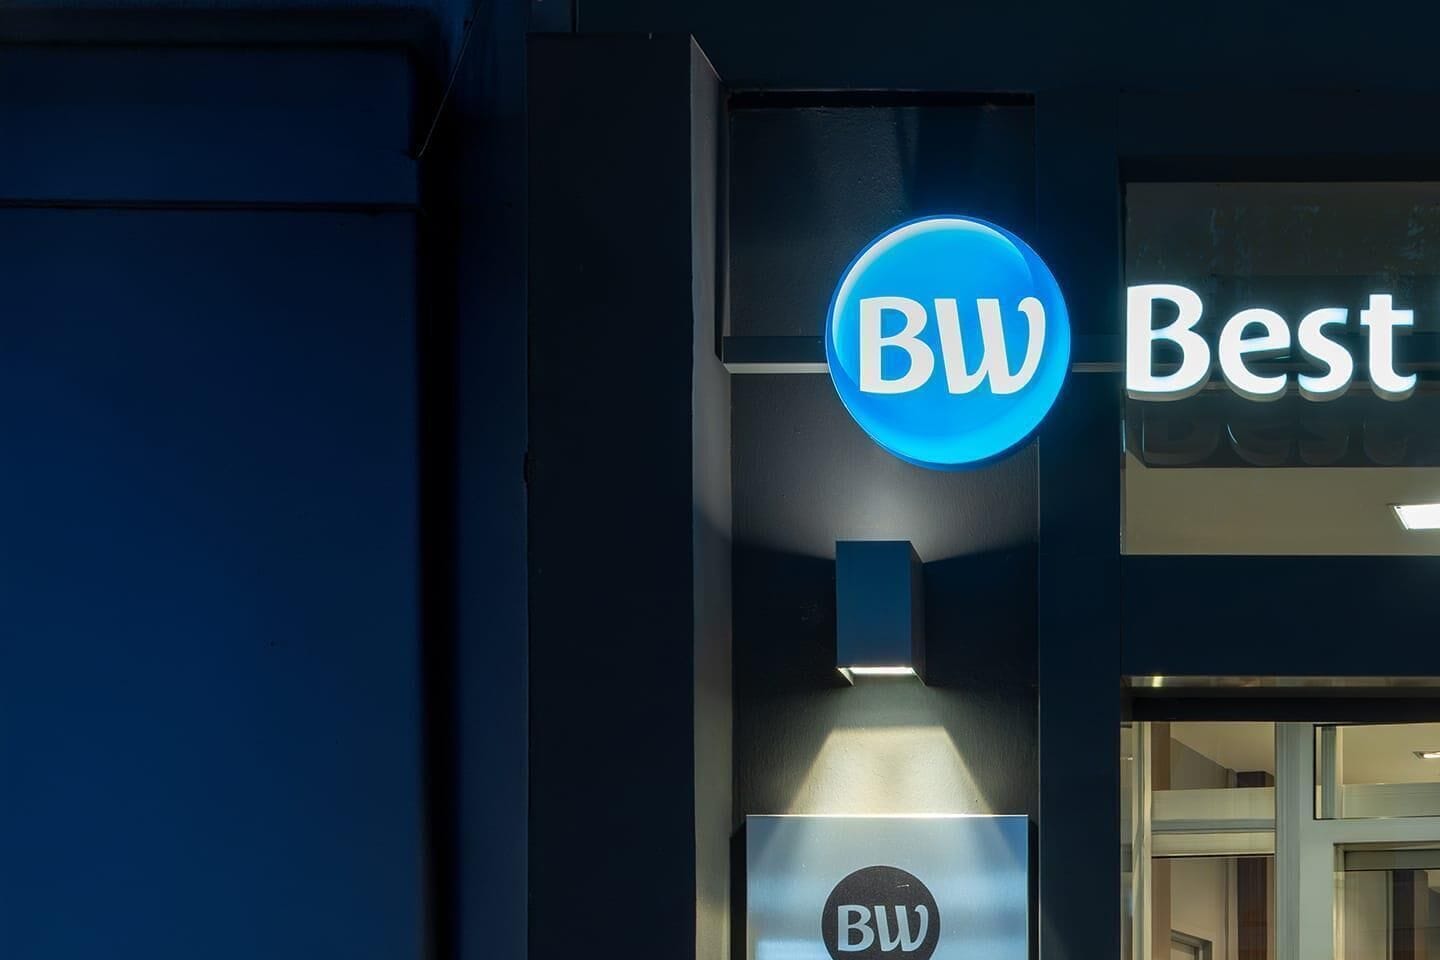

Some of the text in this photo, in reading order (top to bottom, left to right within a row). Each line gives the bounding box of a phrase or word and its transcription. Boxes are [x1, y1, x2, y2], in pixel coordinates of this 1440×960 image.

[860, 297, 1046, 395] BW
[1126, 284, 1417, 399] Best
[837, 904, 929, 952] BW
